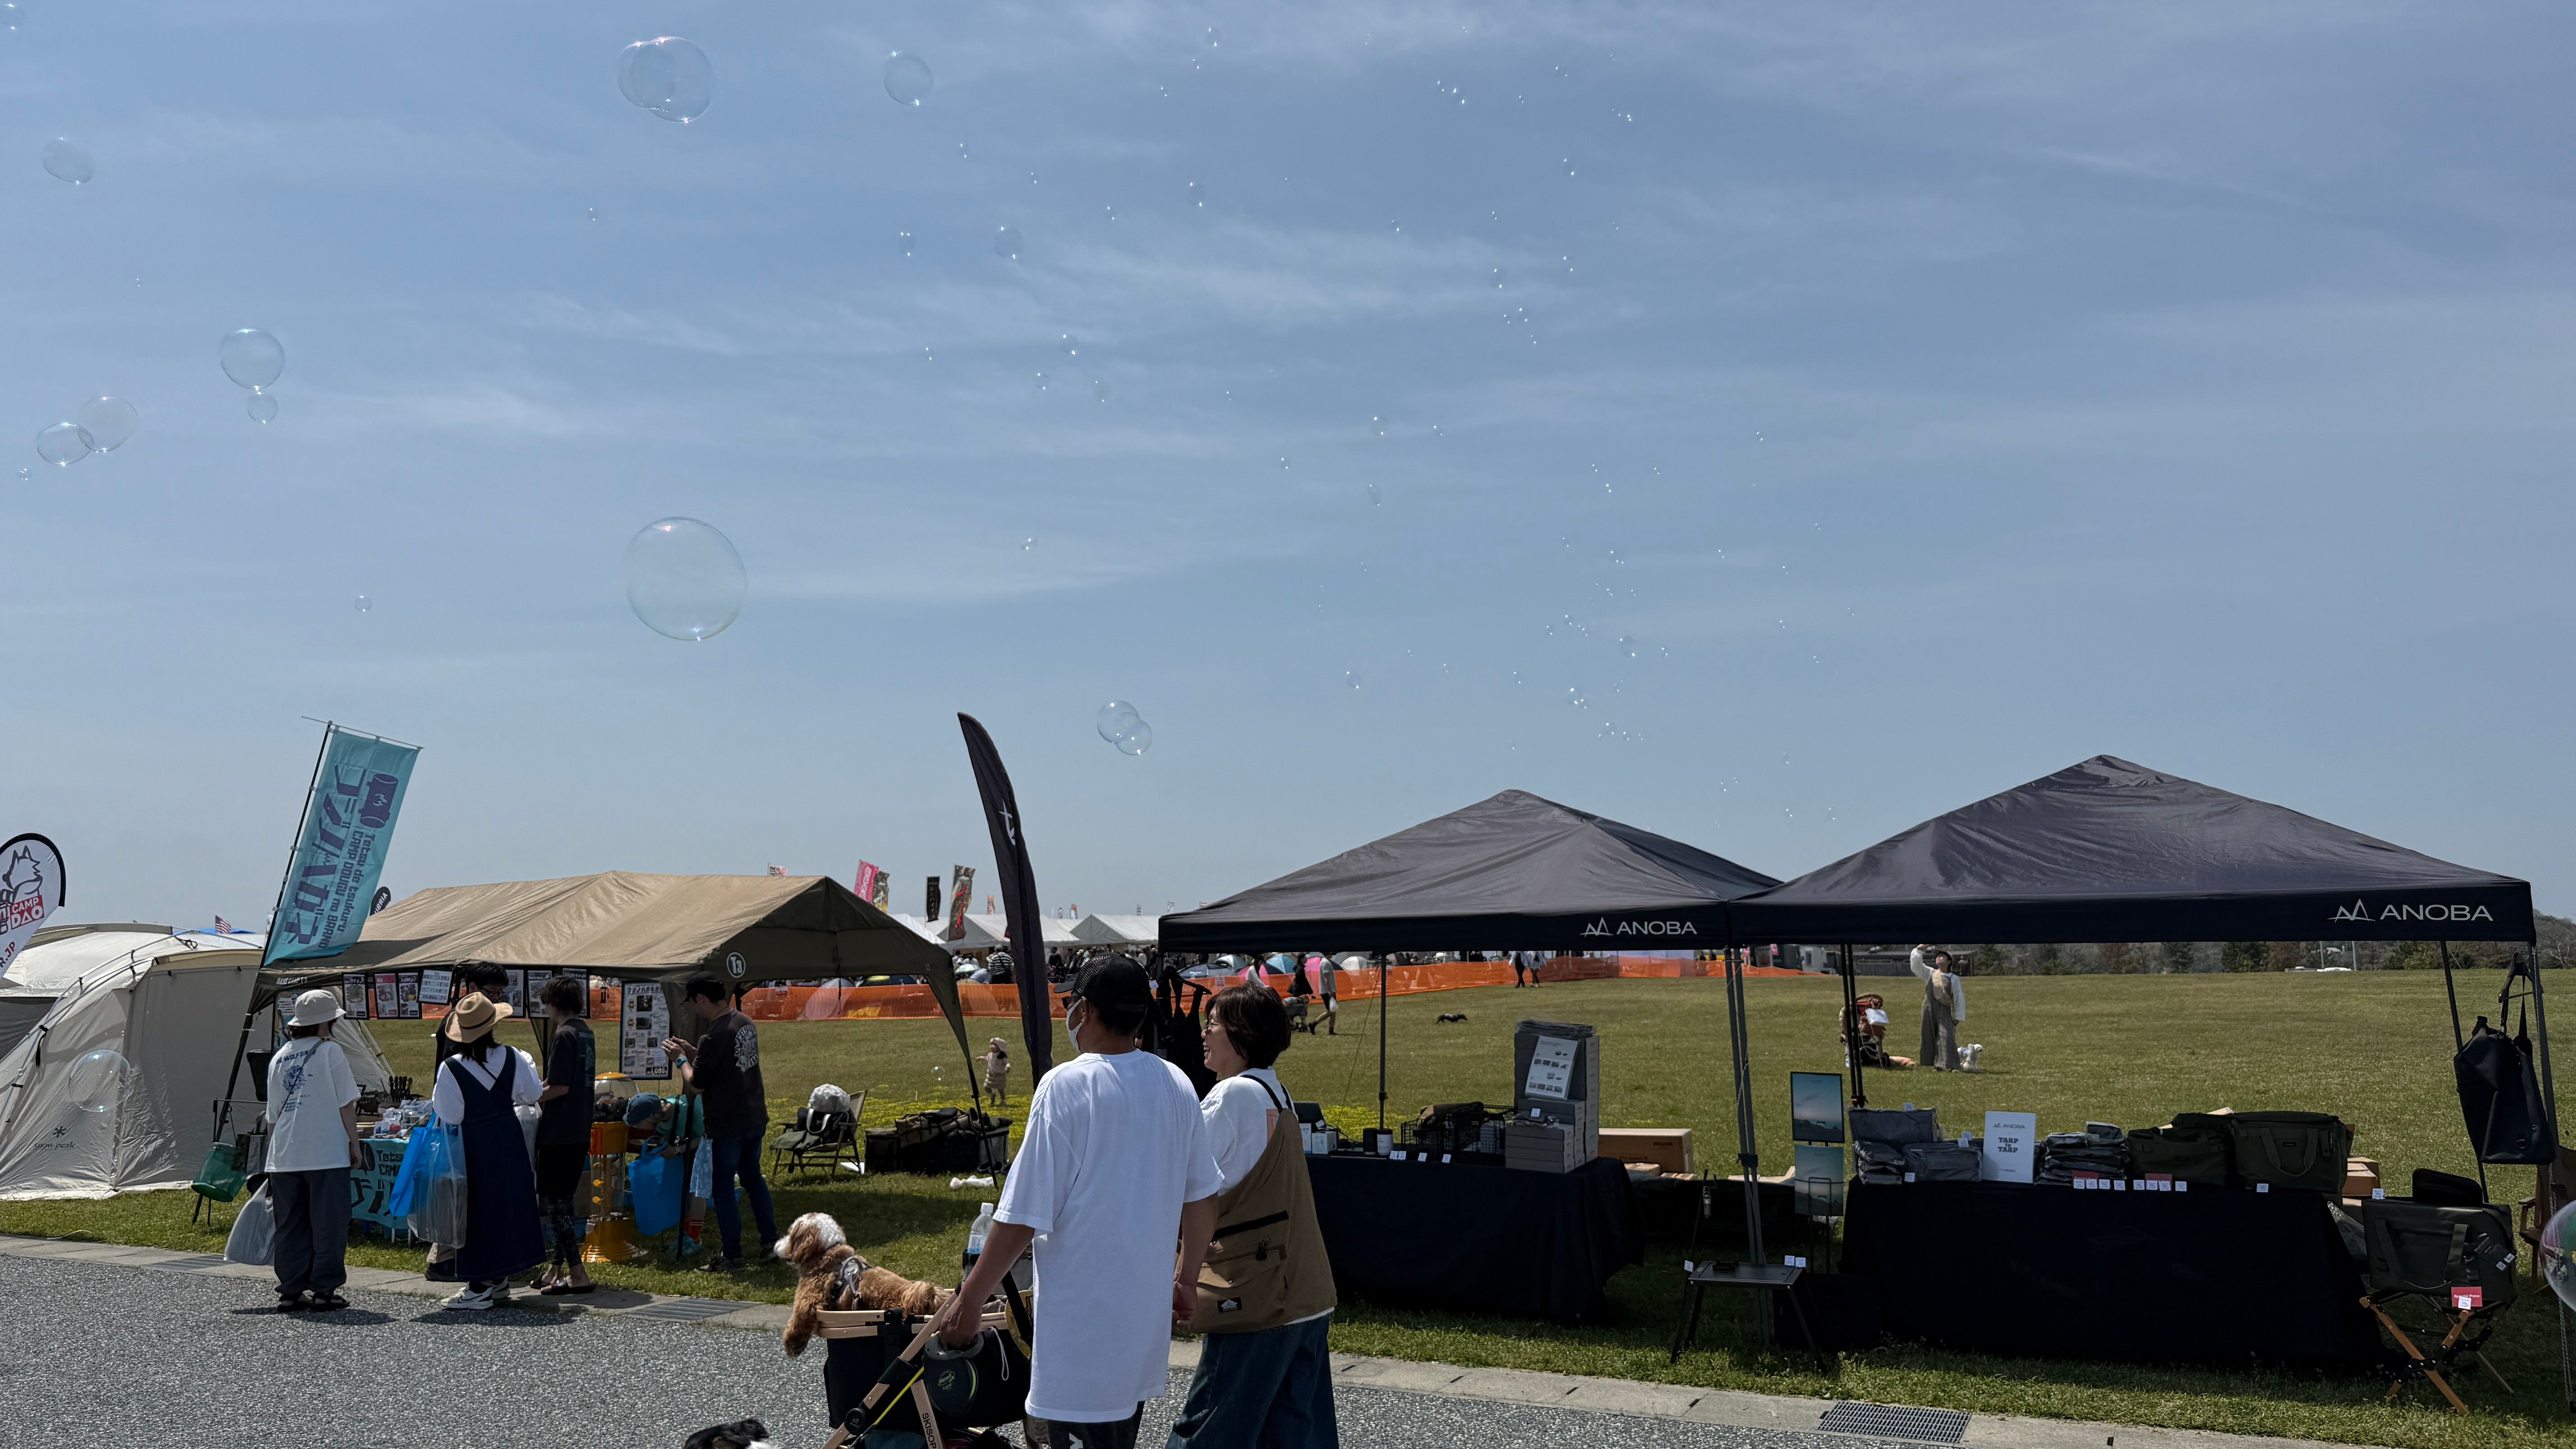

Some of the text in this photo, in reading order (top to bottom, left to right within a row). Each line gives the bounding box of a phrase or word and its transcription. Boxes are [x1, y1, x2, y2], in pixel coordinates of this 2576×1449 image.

[318, 830, 363, 949] CAMP DOUGU no BRAND
[337, 833, 375, 932] Tetsu de tsukuru
[12, 897, 39, 913] CAMP
[2380, 905, 2493, 921] ANOBA
[1616, 921, 1697, 934] ANOBA
[923, 1412, 936, 1449] SKISOP
